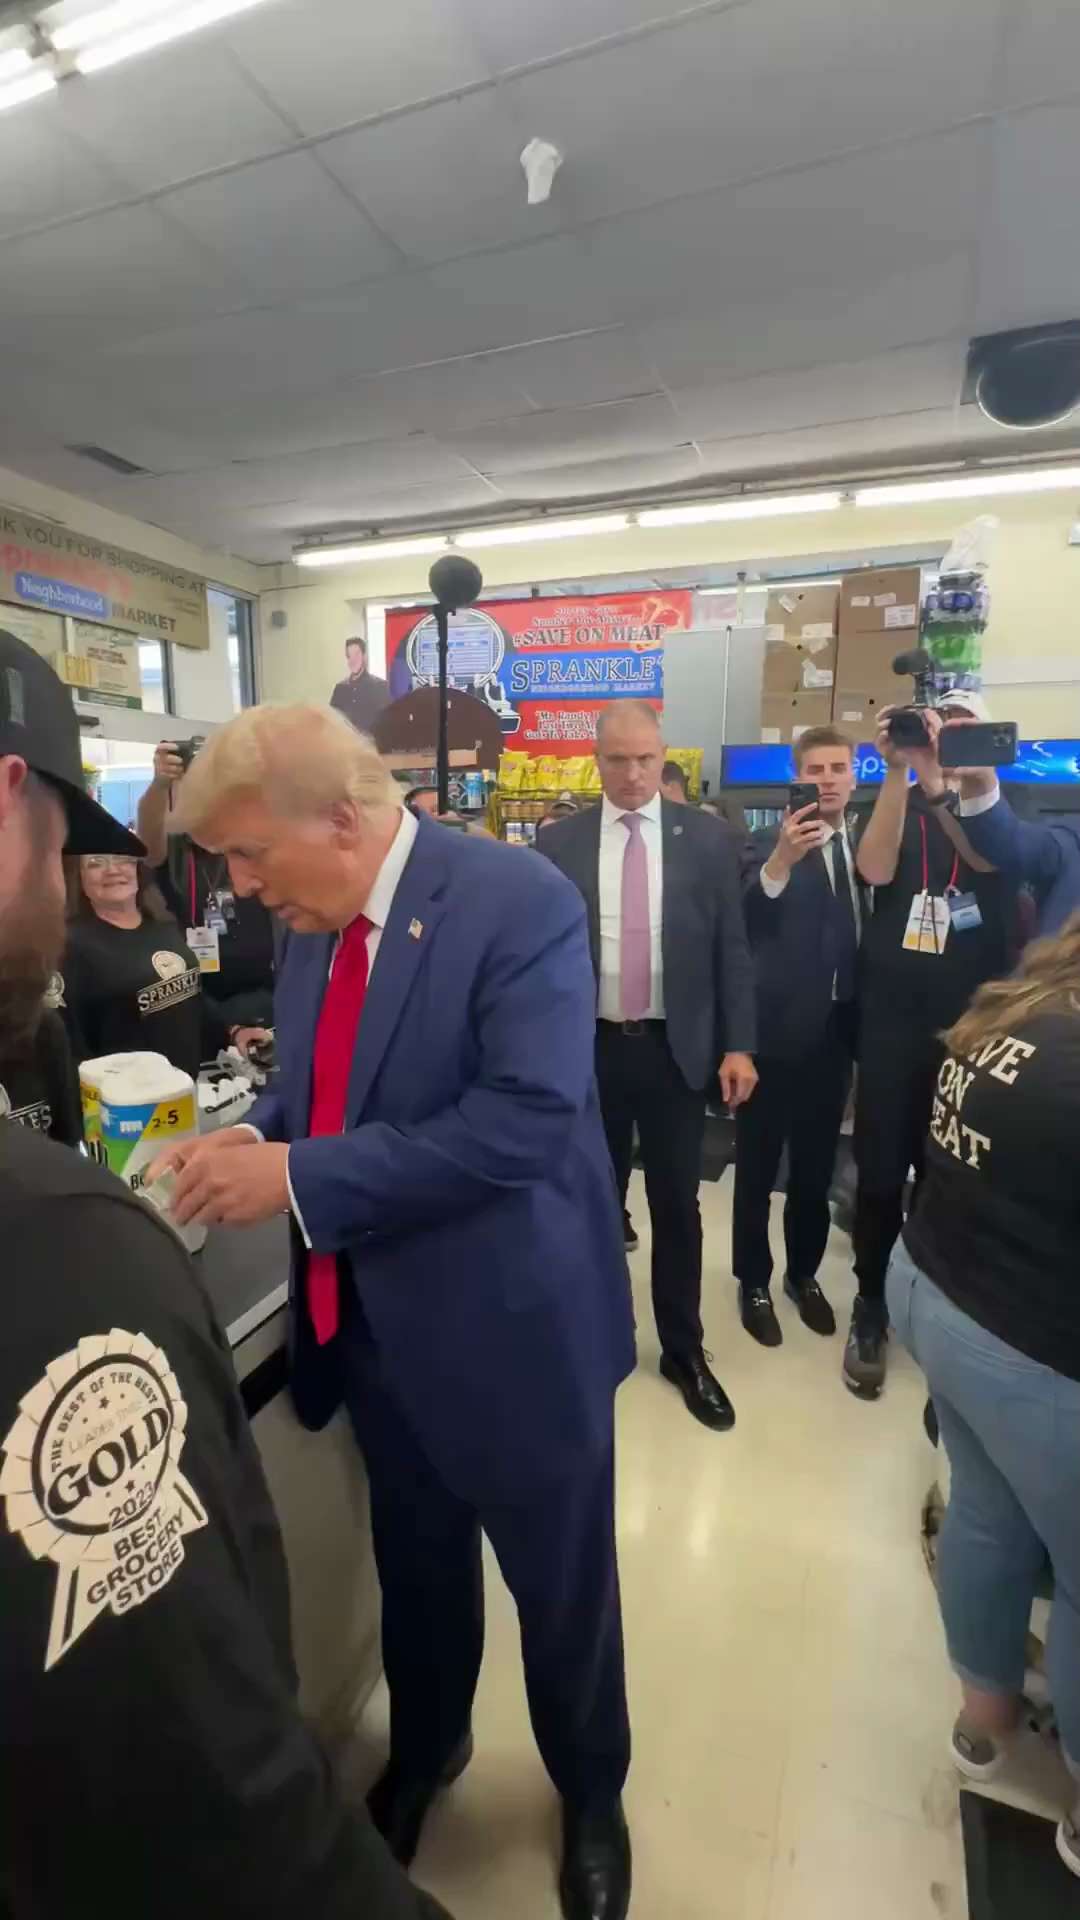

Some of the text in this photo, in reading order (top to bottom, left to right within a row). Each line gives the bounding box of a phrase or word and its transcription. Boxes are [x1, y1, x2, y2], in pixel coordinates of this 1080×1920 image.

[24, 524, 62, 548] YOU
[64, 538, 102, 560] FOR
[107, 551, 186, 589] SHOPPING
[190, 582, 206, 593] AT
[21, 576, 104, 612] Neighborhood
[111, 603, 177, 632] MARKET
[575, 625, 604, 644] ON
[608, 623, 664, 643] MEAT
[511, 654, 664, 692] SPRANKLE'
[852, 756, 888, 780] eps
[938, 1058, 976, 1112] ON
[968, 1036, 1037, 1085] VE
[930, 1095, 991, 1170] EAT
[51, 1371, 158, 1474] THE BEST OF THE BEST
[47, 1407, 169, 1516] GOLD
[109, 1481, 154, 1528] 2023
[86, 1509, 185, 1605] GROCERY
[113, 1509, 161, 1561] BEST
[116, 1544, 182, 1609] STORE
